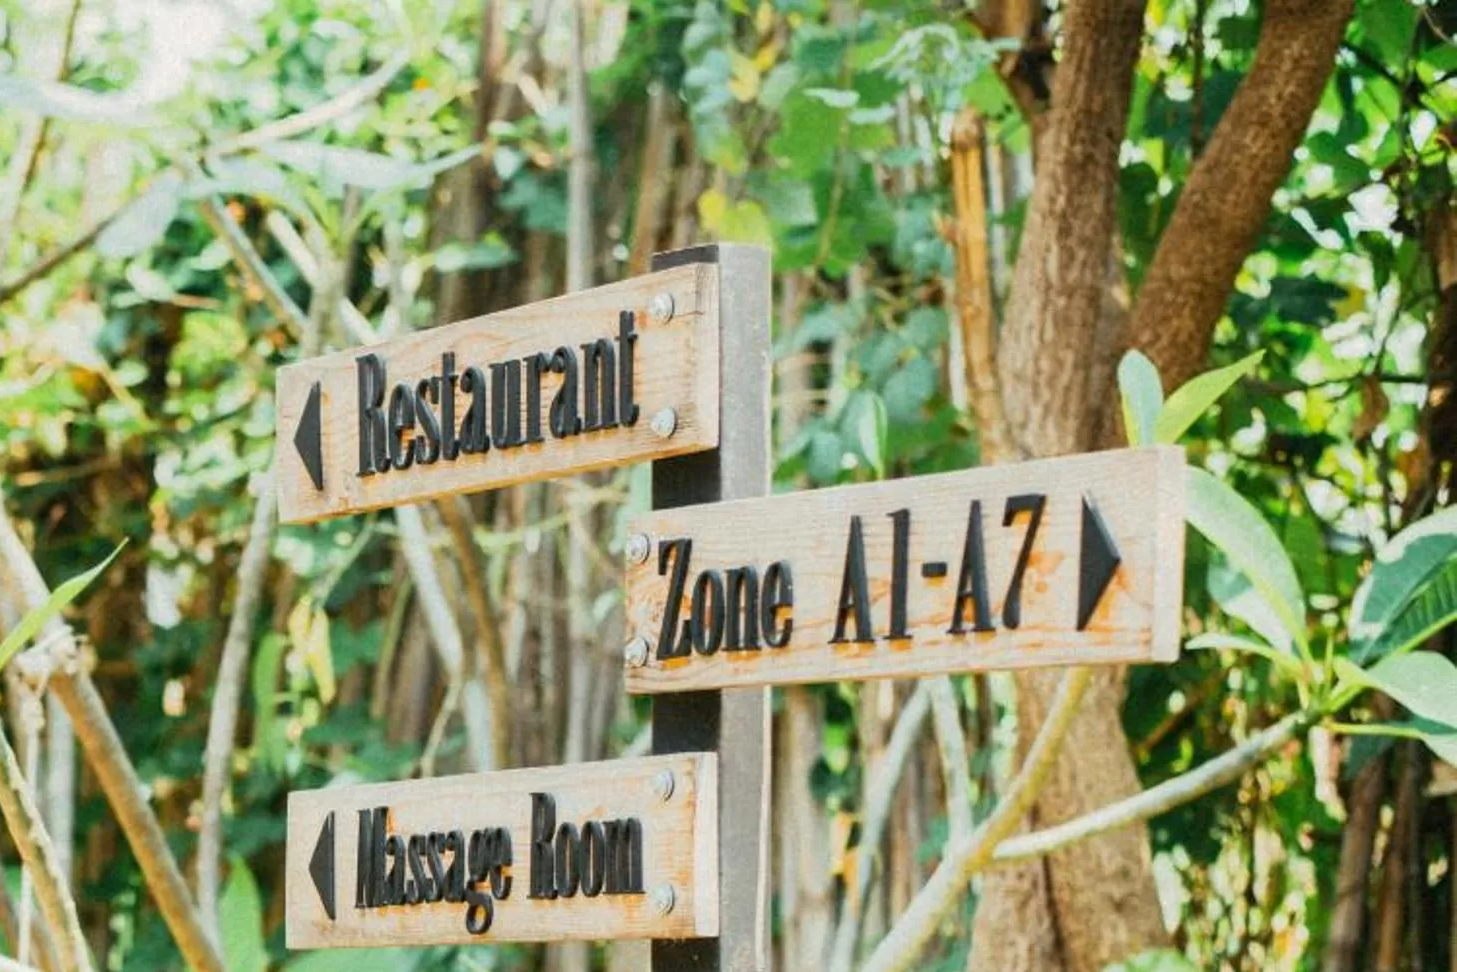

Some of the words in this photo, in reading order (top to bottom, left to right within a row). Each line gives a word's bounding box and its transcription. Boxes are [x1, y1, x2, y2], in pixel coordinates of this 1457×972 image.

[356, 310, 639, 477] Restaurant
[657, 538, 795, 661] Zone
[829, 494, 1046, 644] A1-A7
[355, 806, 512, 934] Massage
[528, 792, 645, 900] Room
